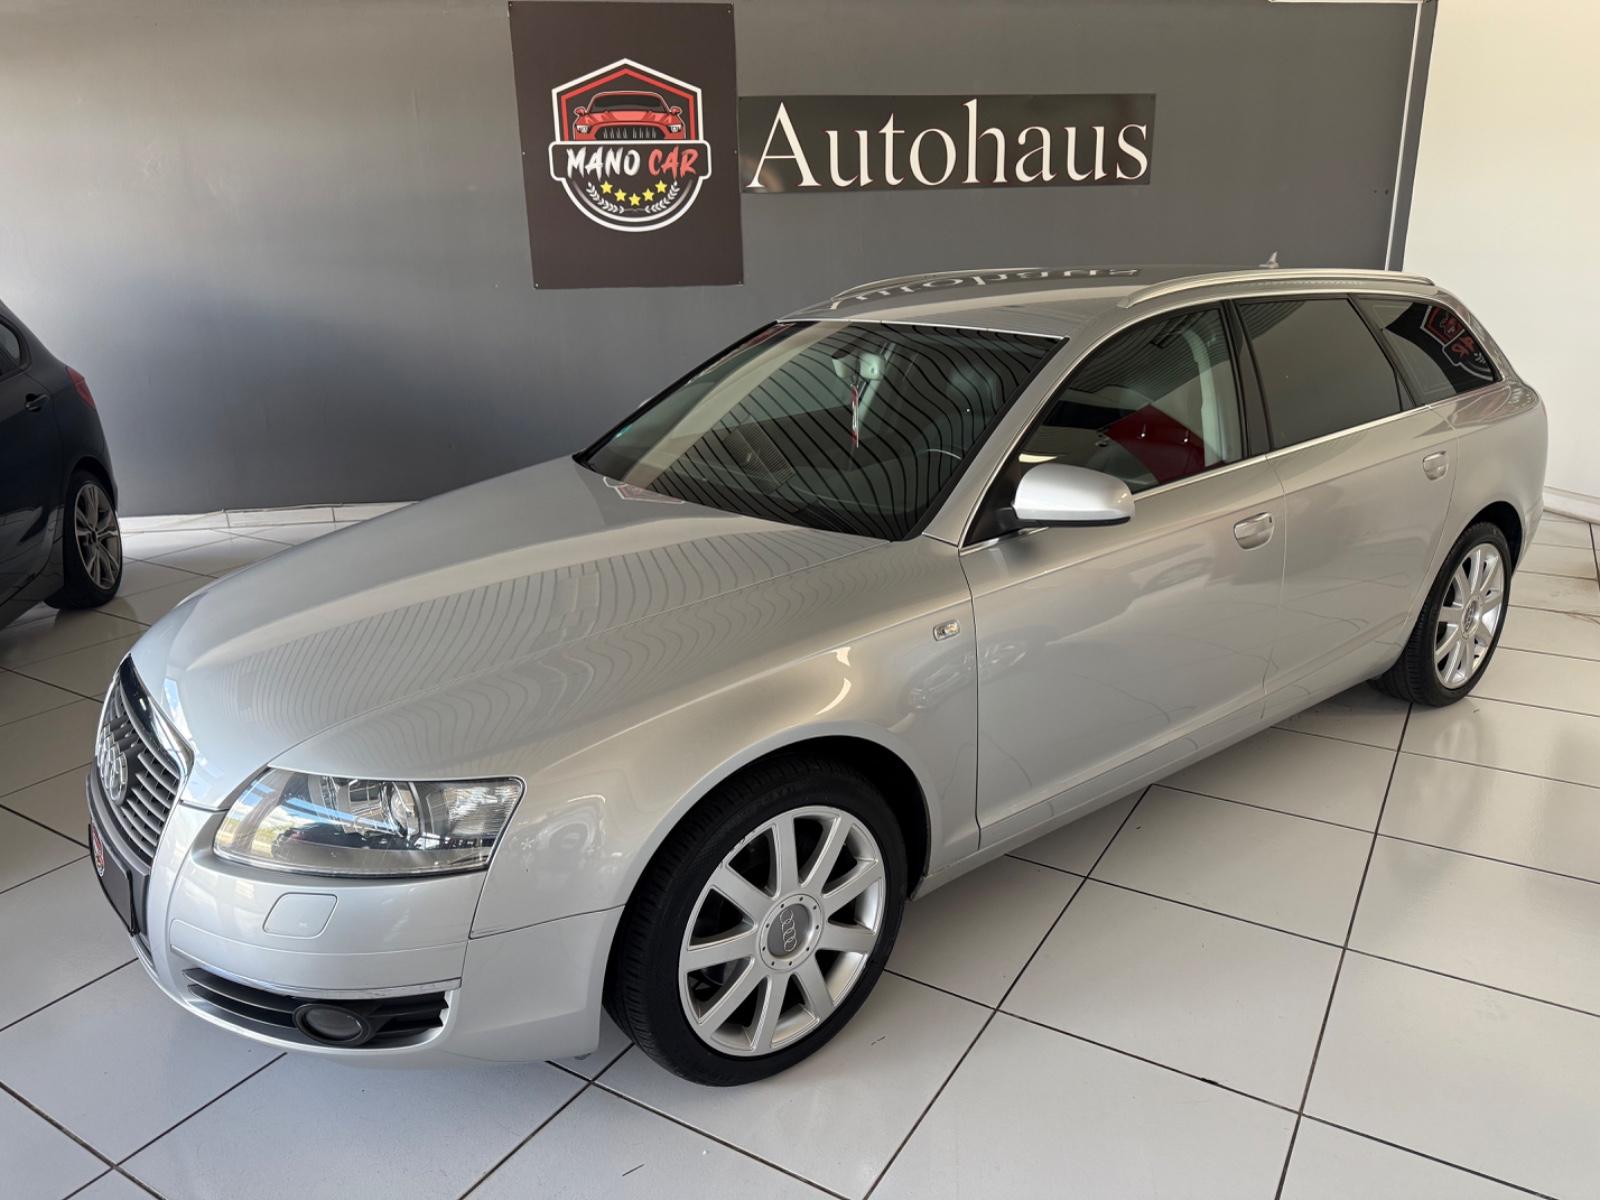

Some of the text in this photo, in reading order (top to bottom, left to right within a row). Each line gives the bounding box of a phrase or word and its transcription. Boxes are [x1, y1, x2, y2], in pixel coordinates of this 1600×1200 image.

[566, 145, 699, 181] MANO CAR
[745, 98, 1148, 188] Autohaus
